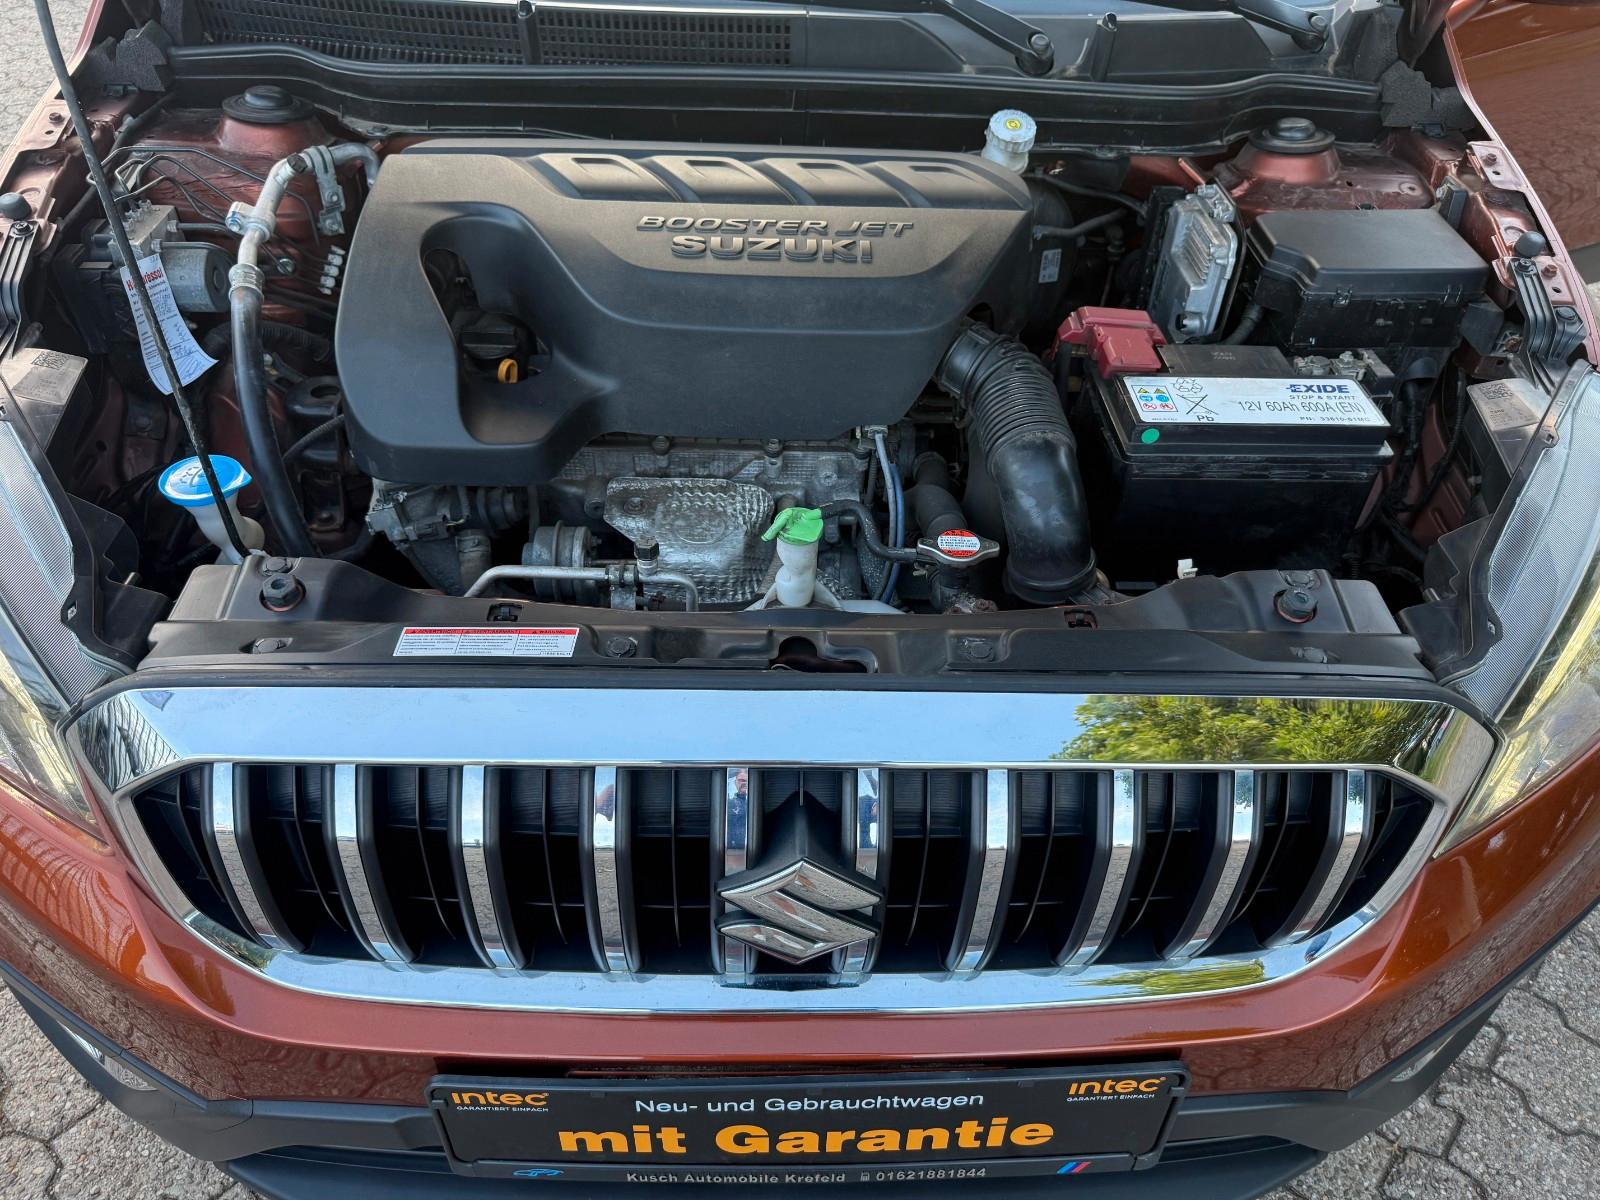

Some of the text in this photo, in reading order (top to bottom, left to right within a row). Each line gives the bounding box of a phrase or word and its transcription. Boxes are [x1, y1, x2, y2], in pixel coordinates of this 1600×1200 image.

[637, 215, 914, 237] BOOSTER JET
[670, 235, 873, 263] SUZUKI
[1286, 383, 1351, 394] EXIDE
[1238, 401, 1263, 412] 12V
[1266, 401, 1300, 413] 60Ah
[1196, 414, 1215, 422] Pb
[1068, 1078, 1161, 1095] intec
[451, 1091, 548, 1106] intec
[635, 1094, 984, 1113] Neu- und Gebrauchtwagen
[558, 1116, 1054, 1155] mit Garantie
[626, 1168, 987, 1184] Kusch Automobile Krefeld 01621881844
